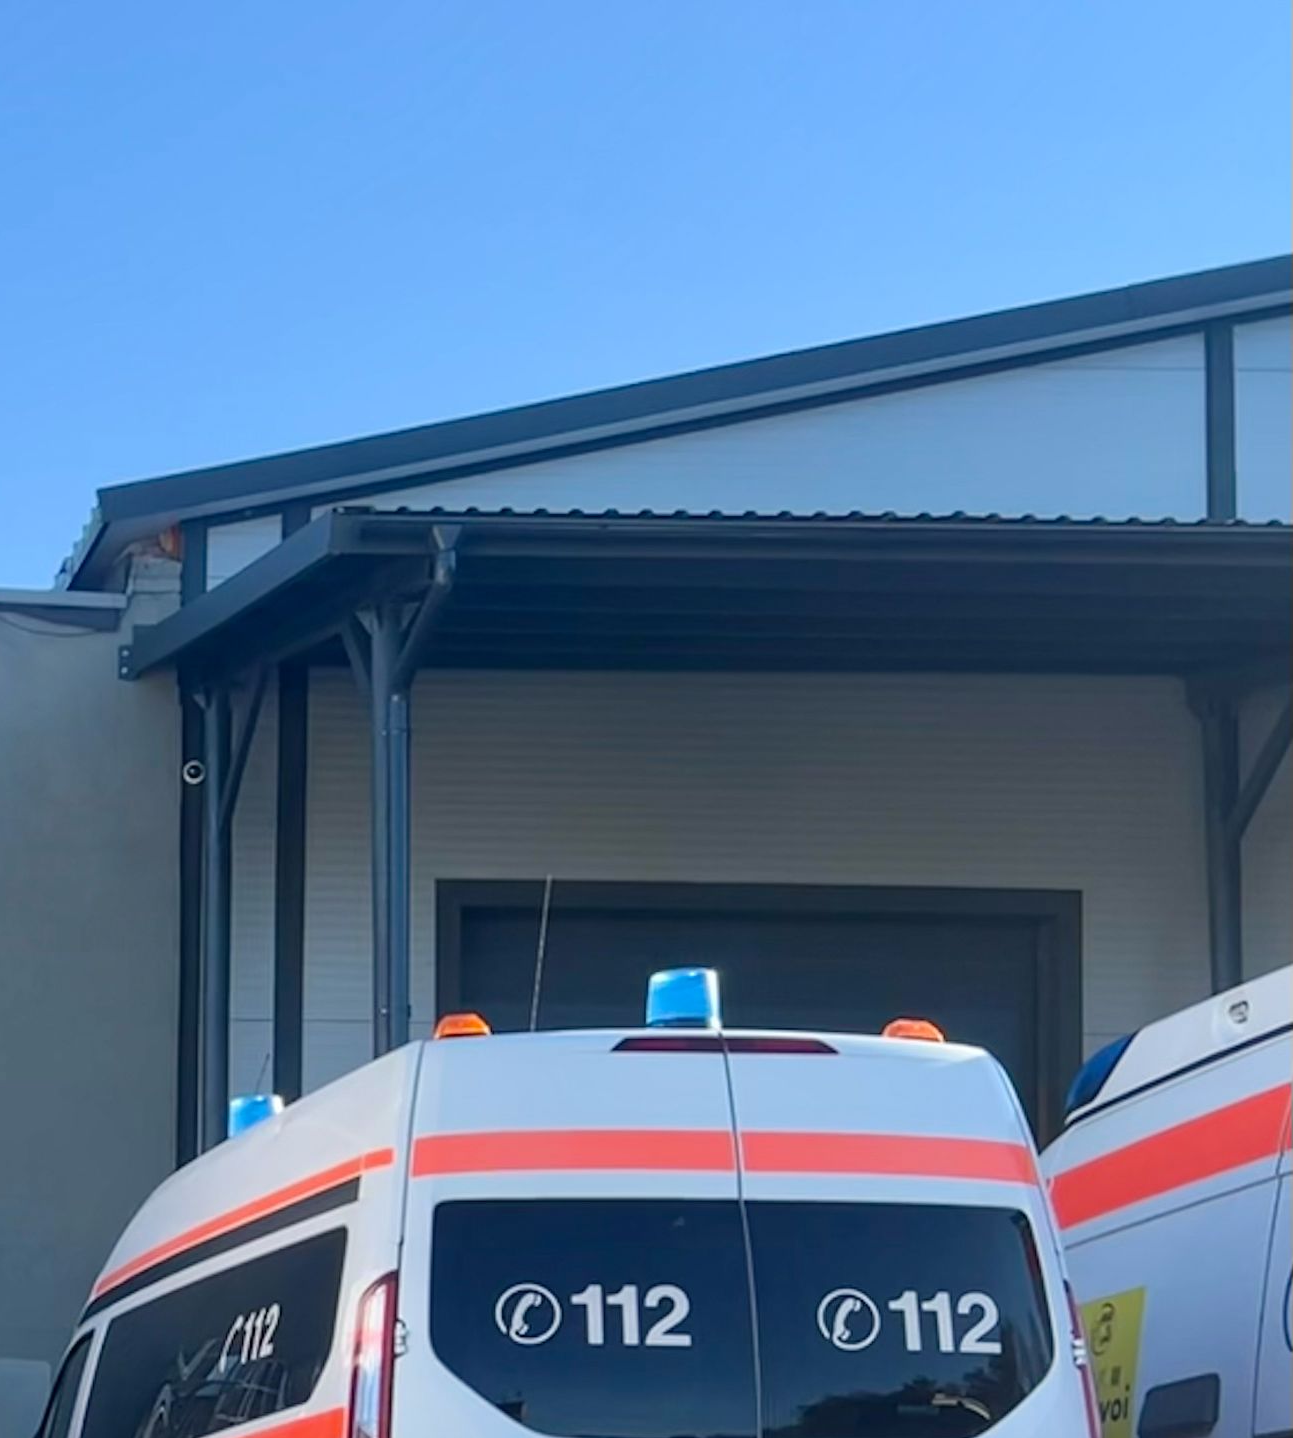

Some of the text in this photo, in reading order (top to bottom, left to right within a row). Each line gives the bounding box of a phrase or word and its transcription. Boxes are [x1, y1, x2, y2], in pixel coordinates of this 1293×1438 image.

[240, 1303, 281, 1365] 112
[570, 1283, 692, 1347] 112
[888, 1290, 1002, 1354] 112
